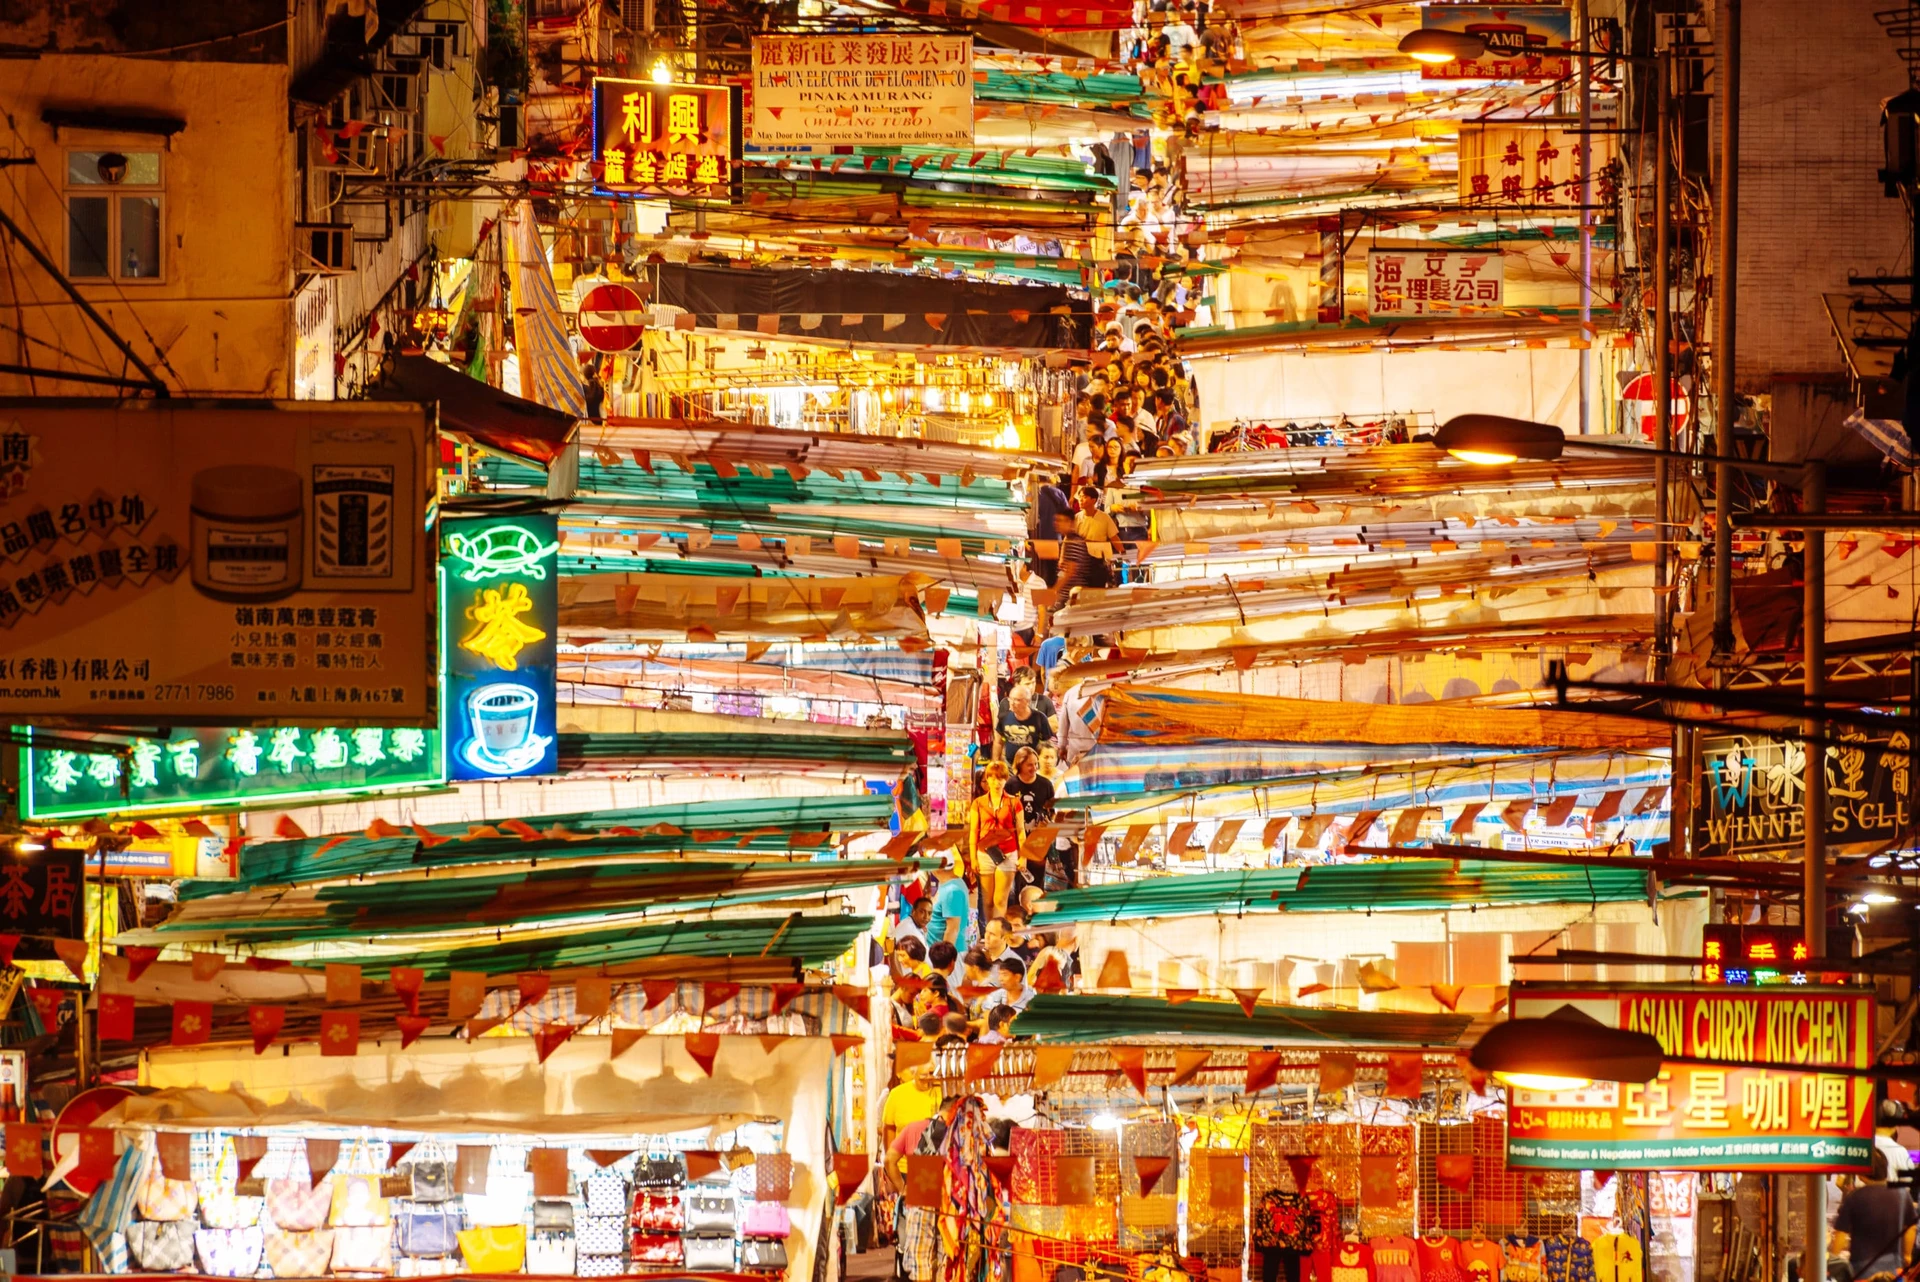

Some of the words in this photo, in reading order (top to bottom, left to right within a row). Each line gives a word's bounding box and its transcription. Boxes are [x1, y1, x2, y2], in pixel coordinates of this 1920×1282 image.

[760, 41, 967, 66] 麗新電業發展公司
[782, 71, 803, 88] SUN
[807, 70, 862, 88] ELECTRIC
[865, 69, 948, 87] DEVELOPMENT
[950, 69, 966, 87] CO
[800, 91, 932, 101] PINAKAMURANG
[622, 91, 699, 145] 利興
[757, 131, 773, 141] May
[776, 131, 792, 139] Door
[805, 131, 822, 139] Door
[825, 131, 851, 139] Service
[854, 131, 863, 139] Sa
[898, 131, 911, 139] free
[914, 131, 942, 141] delivery
[1406, 278, 1498, 301] 理髮公司
[155, 685, 190, 700] 2771
[198, 685, 234, 700] 7986
[1629, 998, 1683, 1057] ASIAN
[1692, 998, 1758, 1062] CURRY
[1766, 999, 1847, 1064] KITCHEN
[1622, 1069, 1849, 1130] 亞星咖喱
[1510, 1145, 1535, 1157] Better
[1537, 1147, 1560, 1158] Taste
[1561, 1148, 1589, 1159] Indian
[1591, 1148, 1598, 1159] &
[1600, 1149, 1642, 1161] Nepalese
[1644, 1148, 1671, 1158] Home
[1672, 1146, 1699, 1157] Made
[1700, 1145, 1723, 1156] Food
